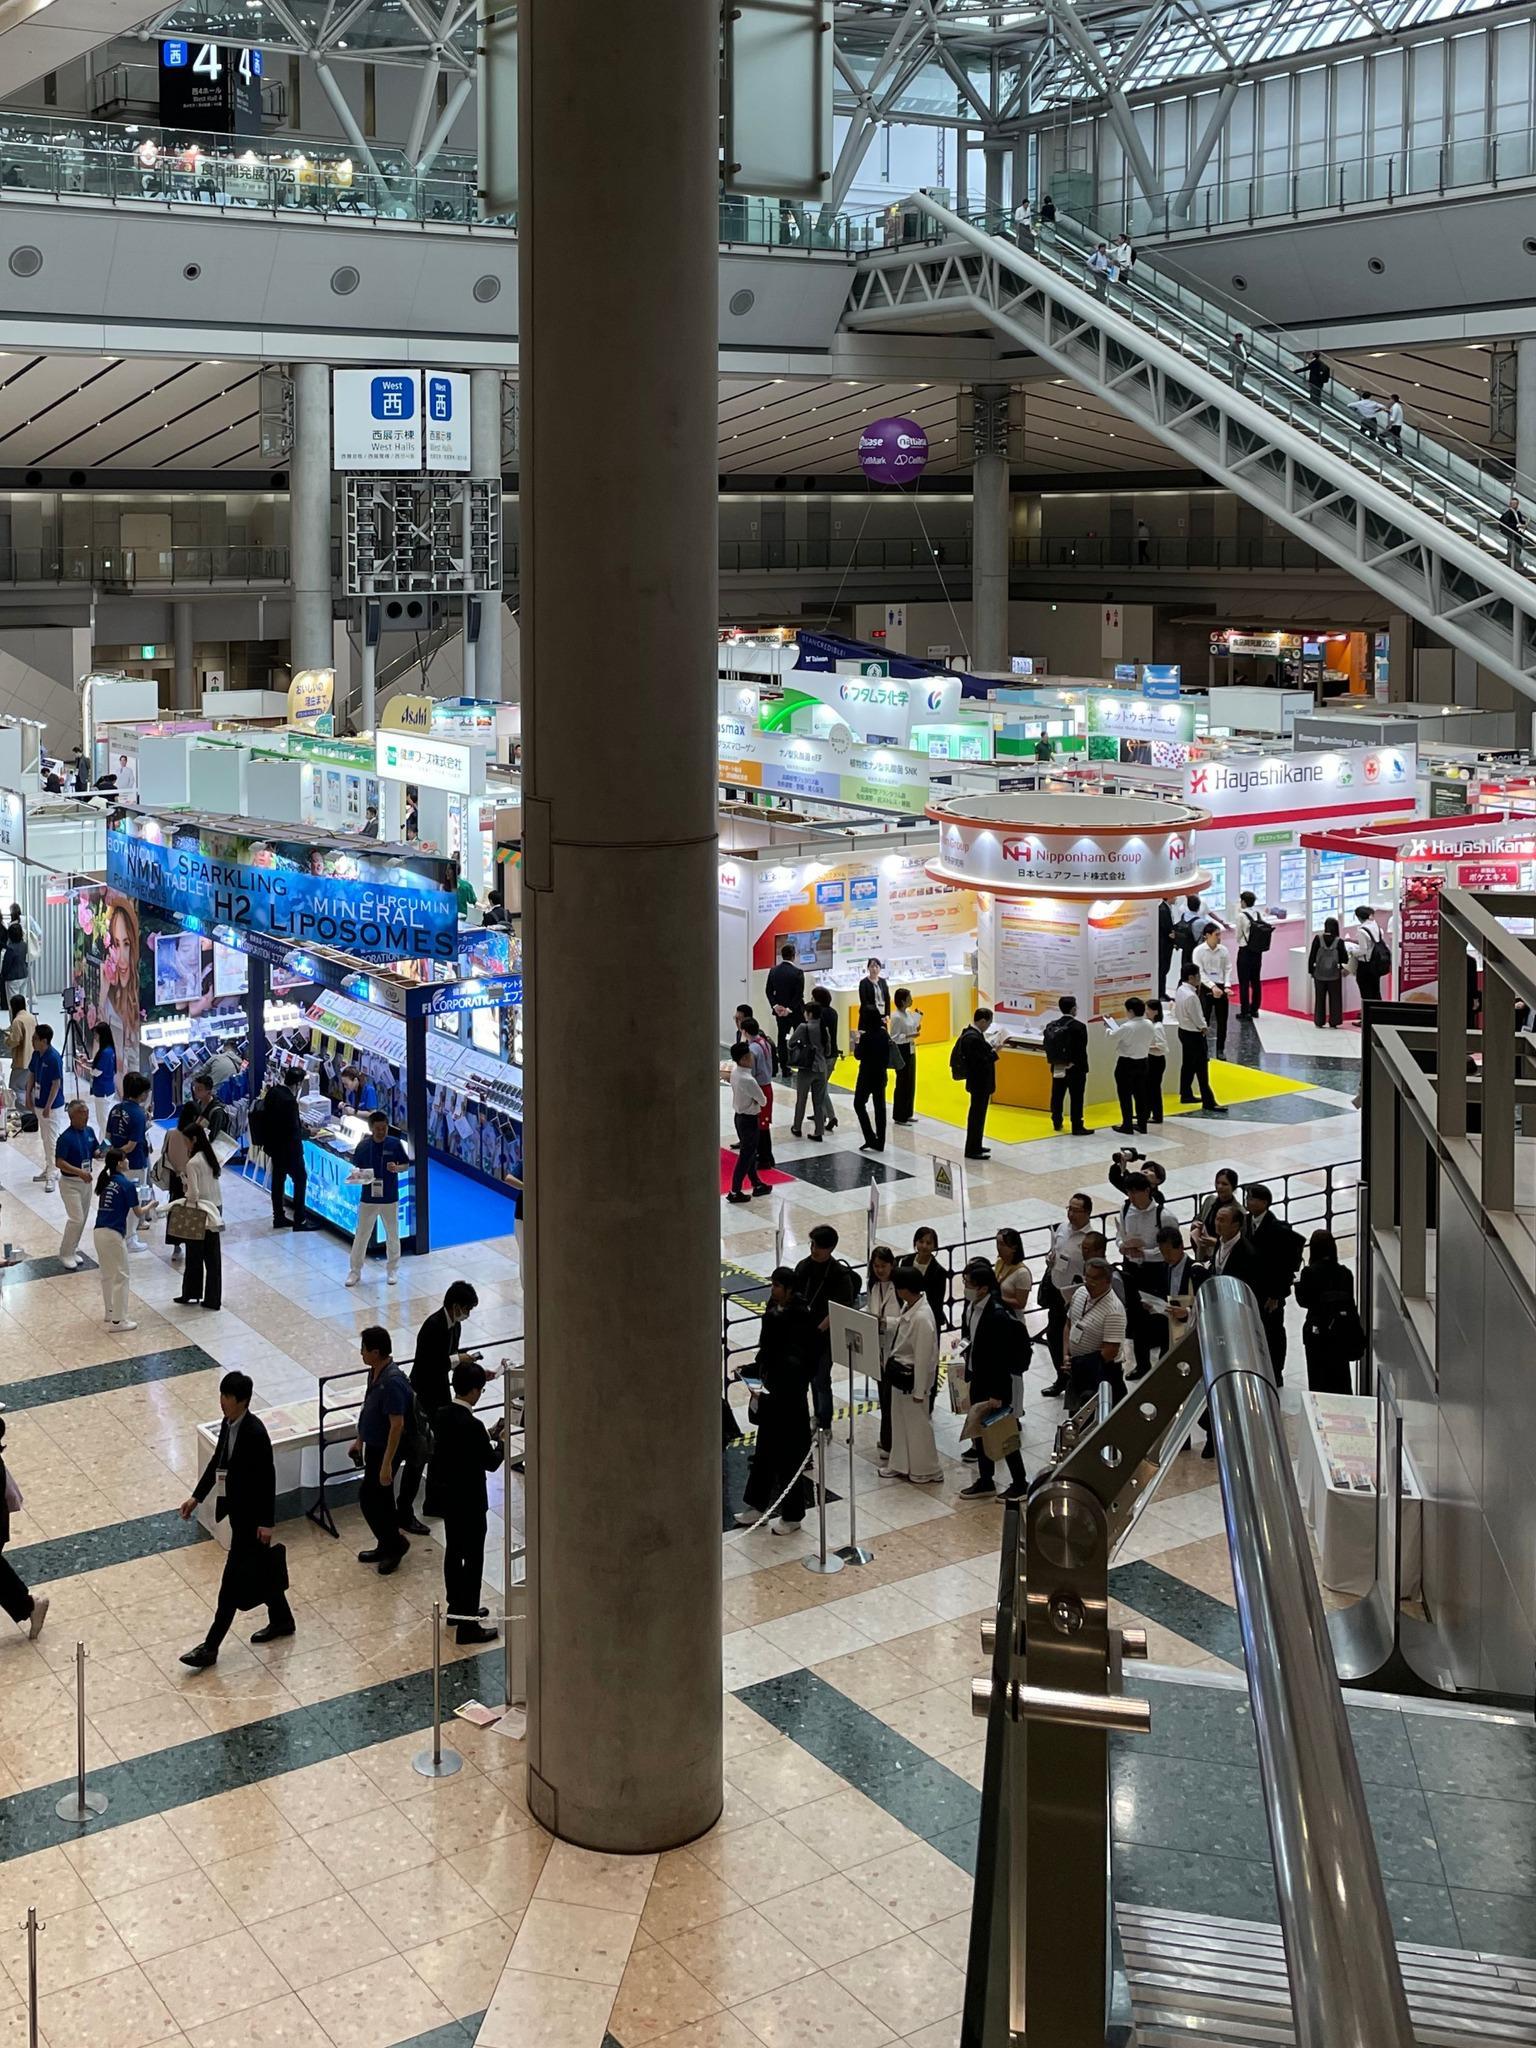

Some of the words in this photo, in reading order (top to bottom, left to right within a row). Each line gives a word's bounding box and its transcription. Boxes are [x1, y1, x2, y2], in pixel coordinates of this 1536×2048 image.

[193, 43, 222, 80] 4
[239, 48, 252, 85] 4
[382, 381, 402, 390] West
[383, 393, 402, 416] 西
[435, 394, 447, 417] 西
[371, 443, 392, 451] West
[395, 442, 415, 451] Halls
[372, 430, 415, 440] 西展示棟
[851, 687, 909, 707] フタムラ化学
[402, 705, 427, 727] Asahi
[1105, 710, 1176, 727] ナットウキナーゼ
[717, 722, 745, 736] smax
[1216, 764, 1323, 793] Hayashikane
[1037, 852, 1105, 863] Nipponham
[1108, 851, 1141, 864] Group
[1432, 837, 1536, 857] Hayashikane
[127, 855, 161, 883] NMN
[178, 854, 287, 896] SPARKLING
[1018, 869, 1126, 881] 日本ピュアフード株式会社
[165, 871, 213, 898] TABLET
[214, 890, 251, 925] H2
[313, 896, 424, 929] MINERAL
[363, 891, 450, 915] CURCUMIN
[270, 903, 454, 956] LIPOSOMES
